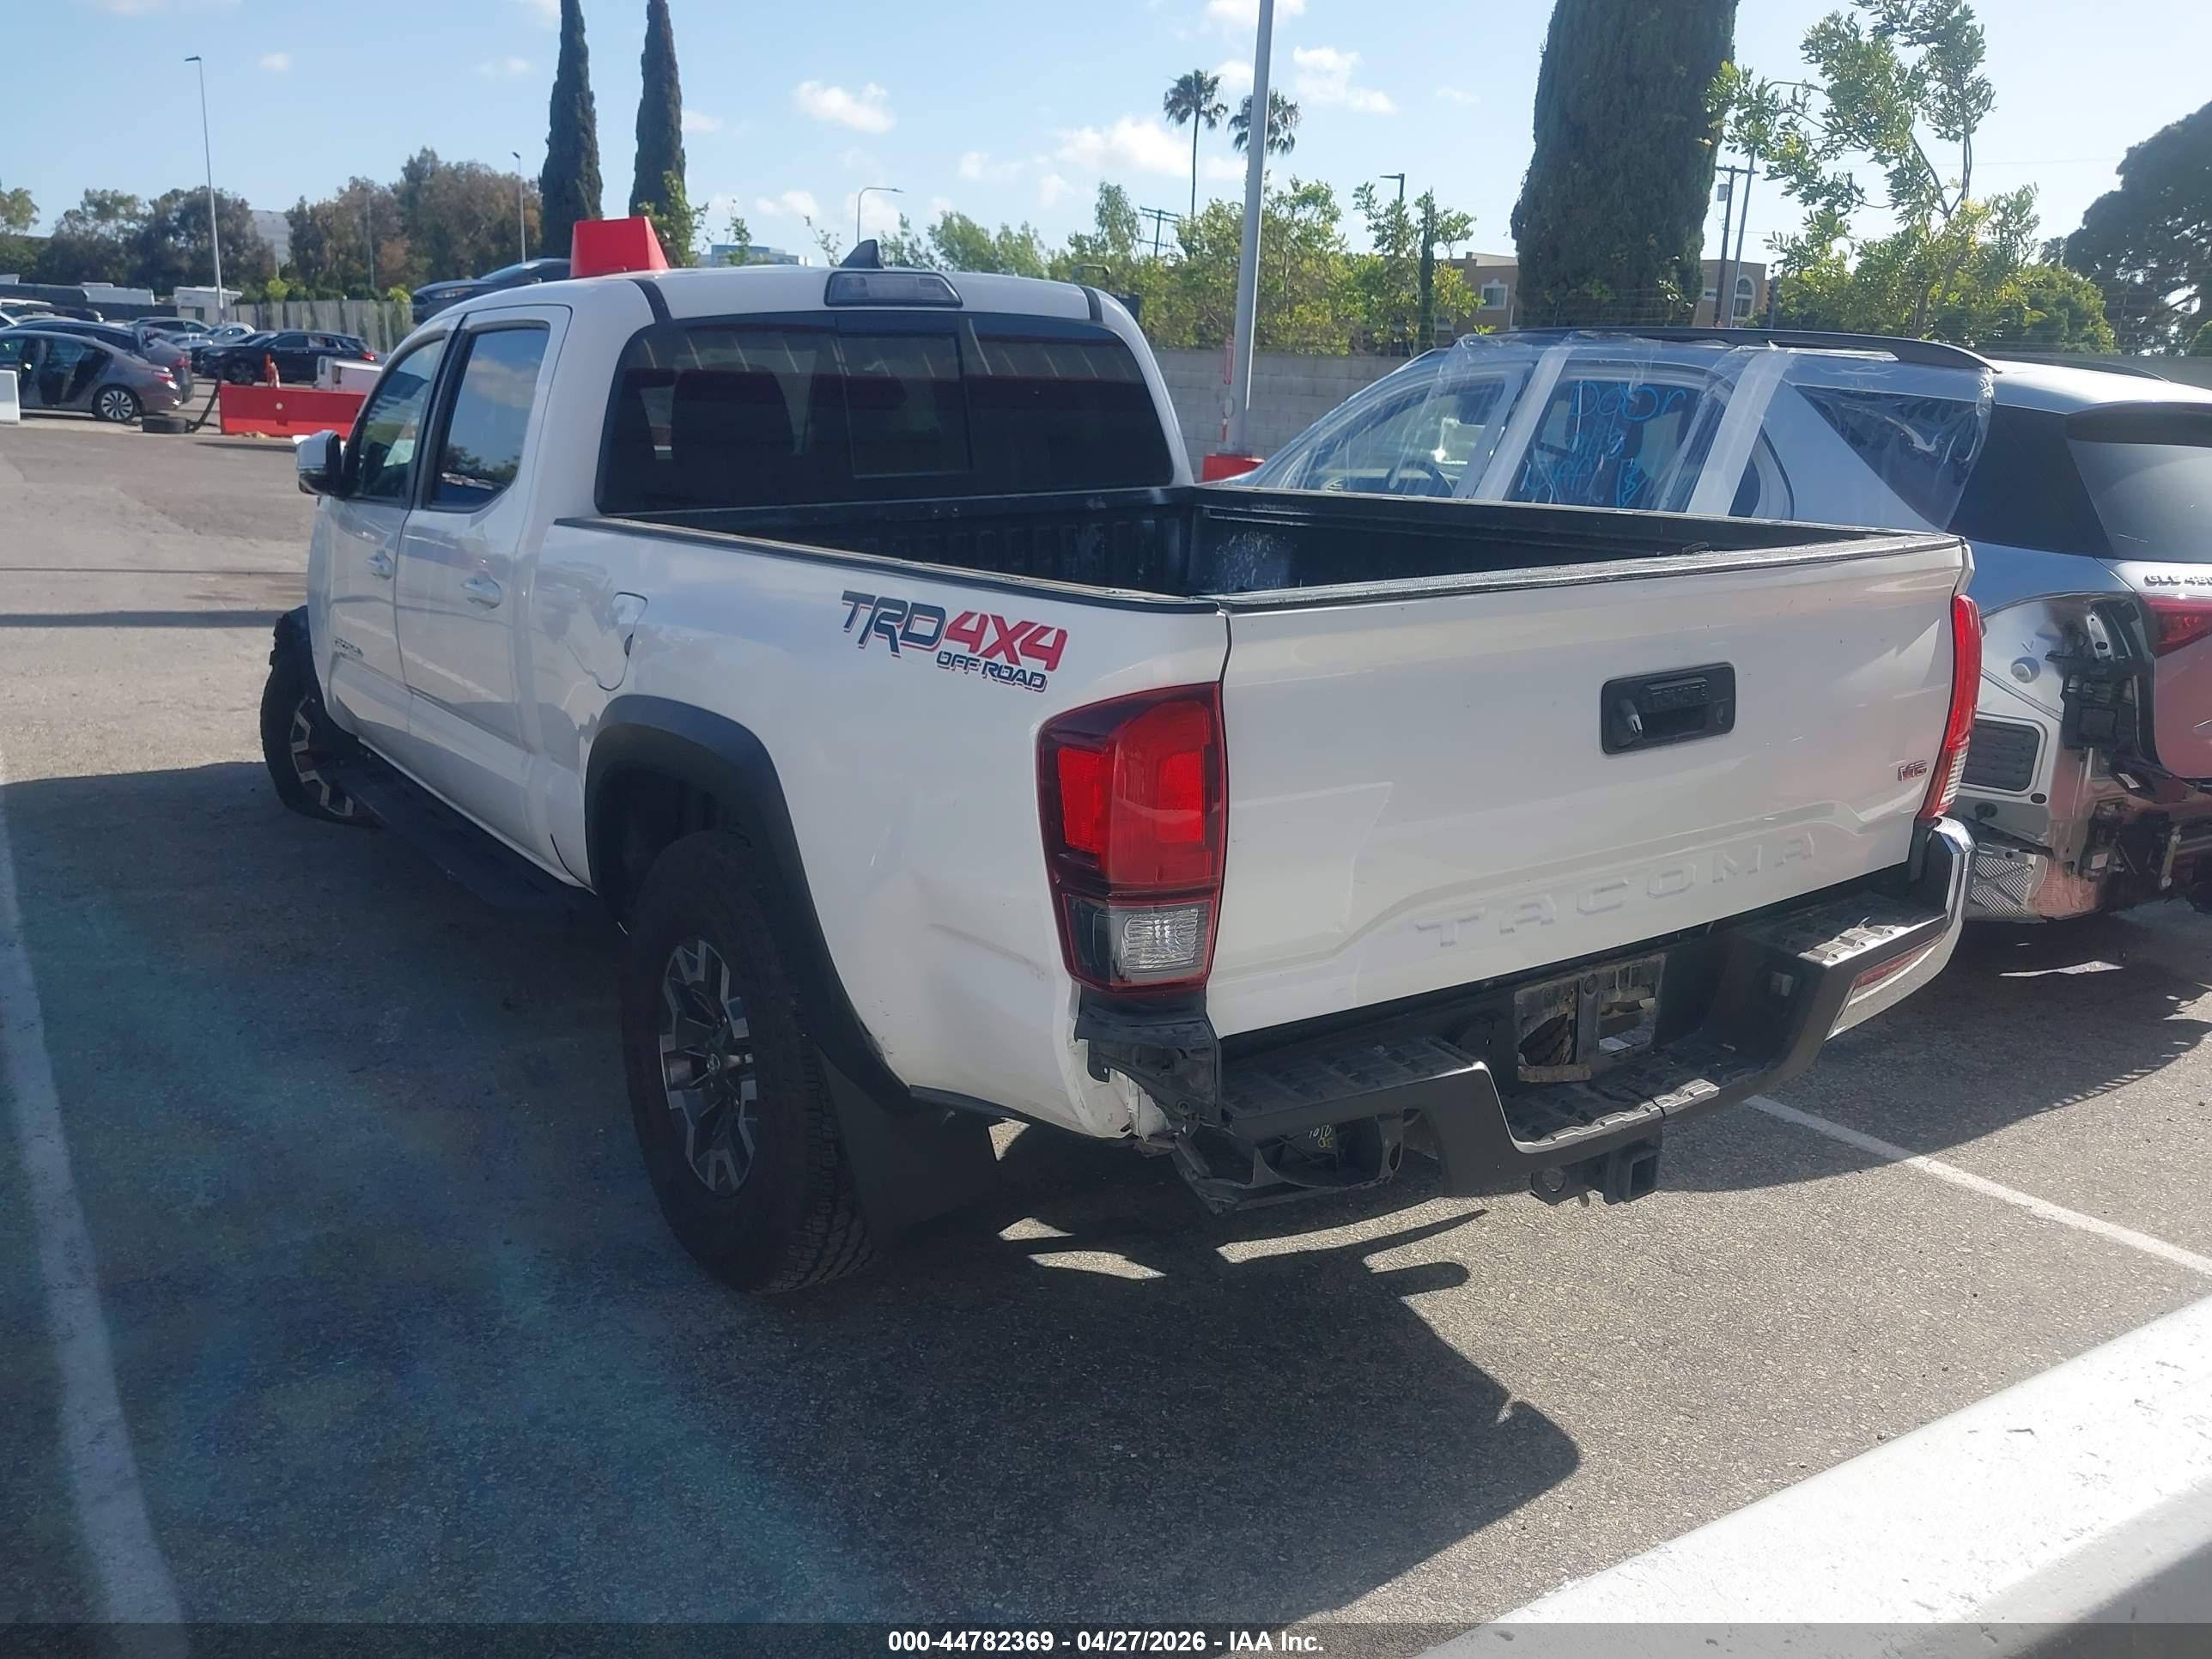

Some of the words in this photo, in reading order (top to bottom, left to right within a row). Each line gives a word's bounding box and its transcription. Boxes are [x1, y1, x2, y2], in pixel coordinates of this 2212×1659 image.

[842, 590, 947, 659] TRD
[936, 650, 981, 675] OFF
[980, 660, 1048, 693] ROAD
[1415, 830, 1816, 947] TACOMA
